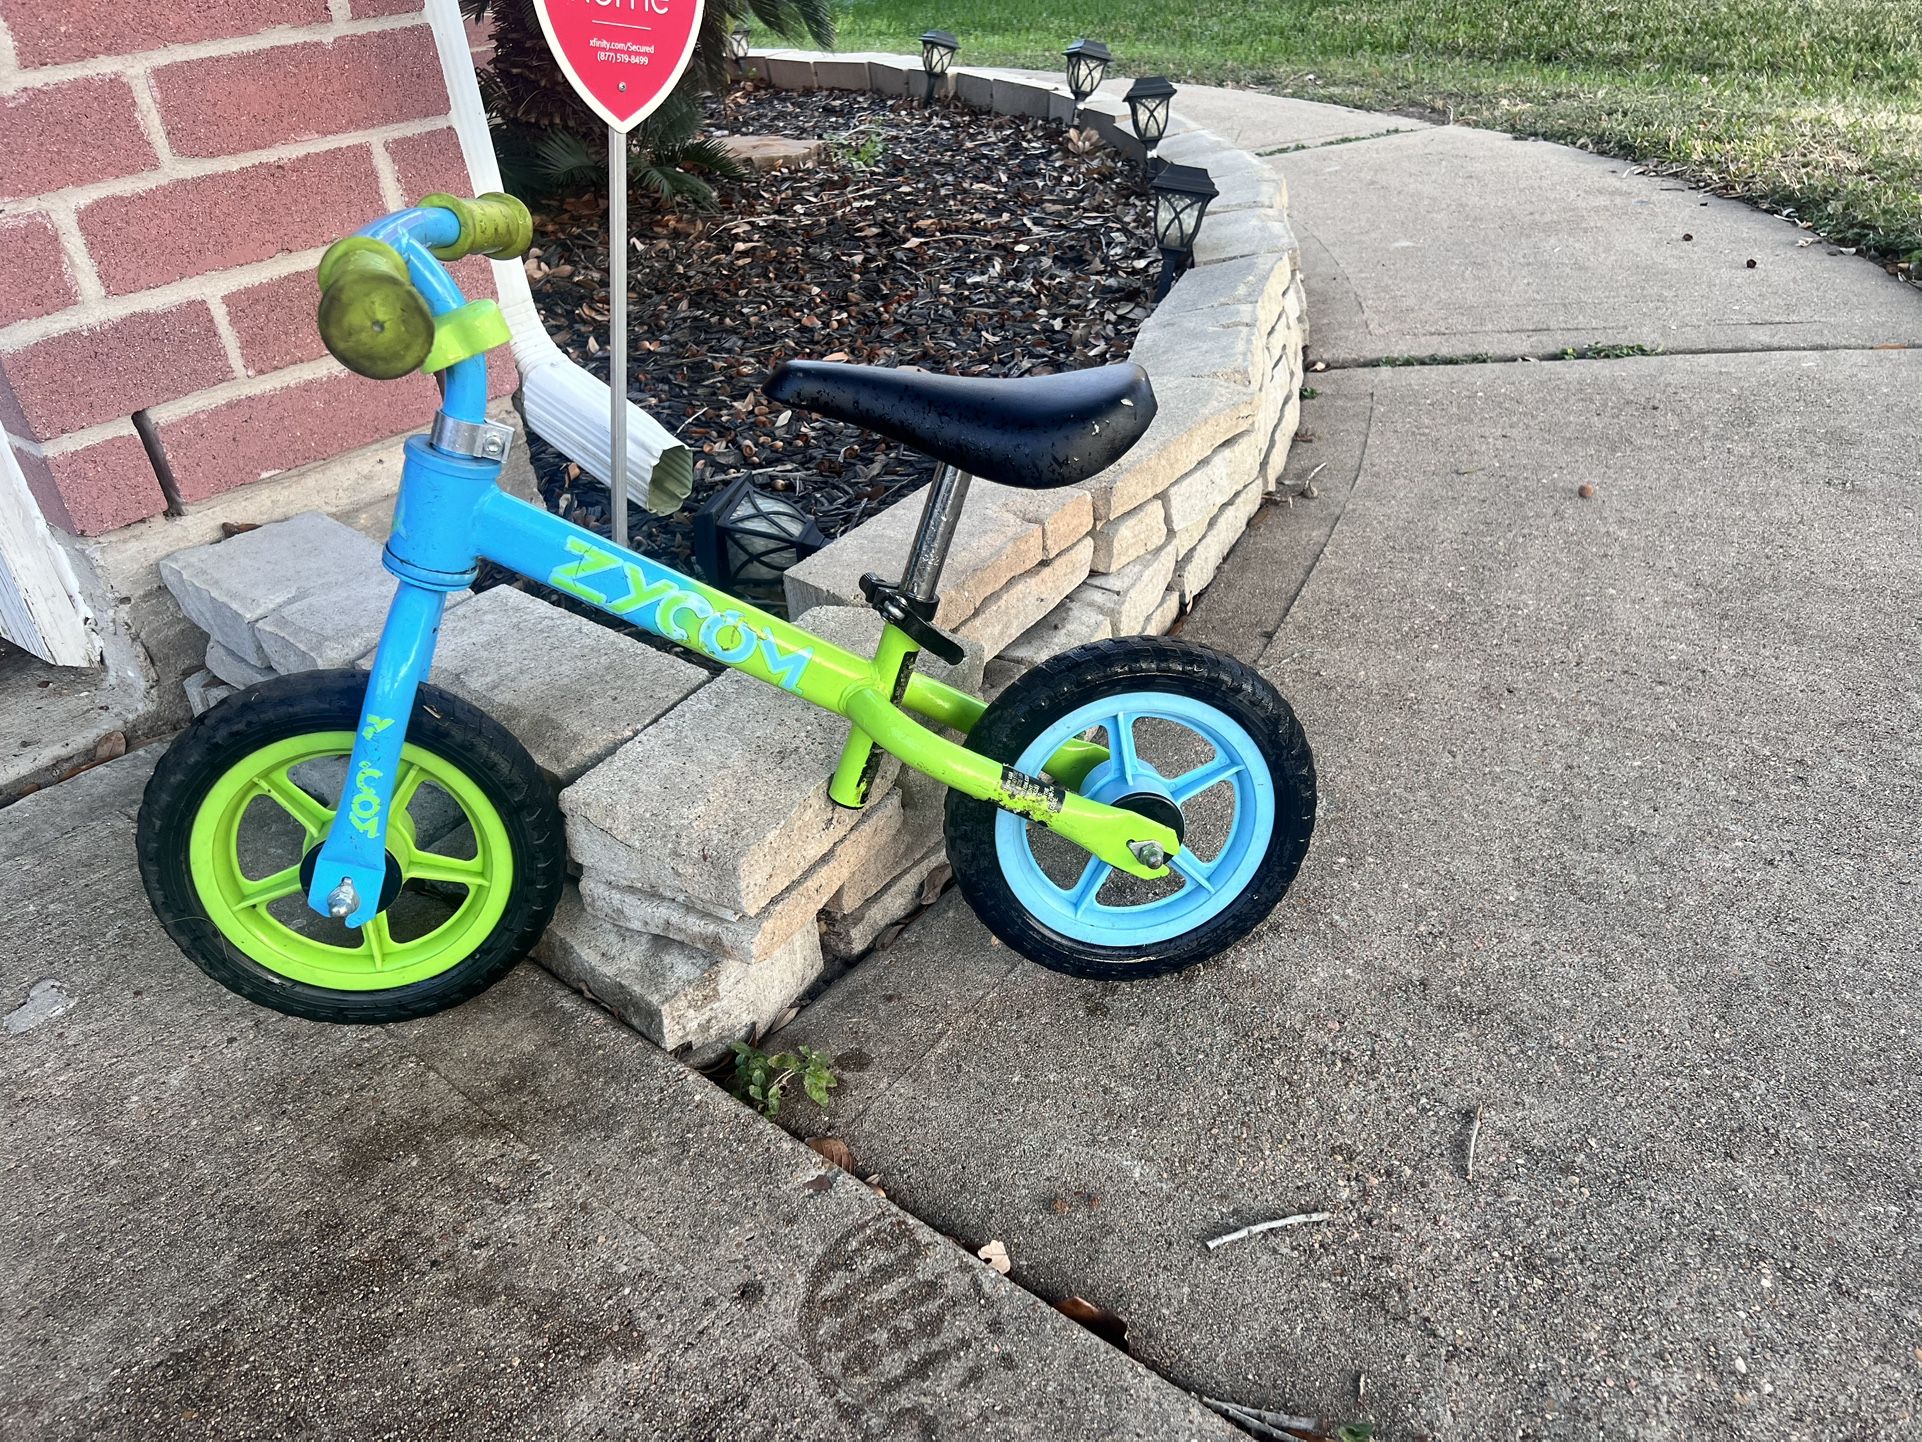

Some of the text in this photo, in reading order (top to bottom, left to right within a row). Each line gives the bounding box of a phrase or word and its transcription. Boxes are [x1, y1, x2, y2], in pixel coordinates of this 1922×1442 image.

[589, 38, 655, 54] xfinity.com/Secured
[597, 51, 649, 65] (877) 519-8499
[548, 535, 815, 696] ZYCOM
